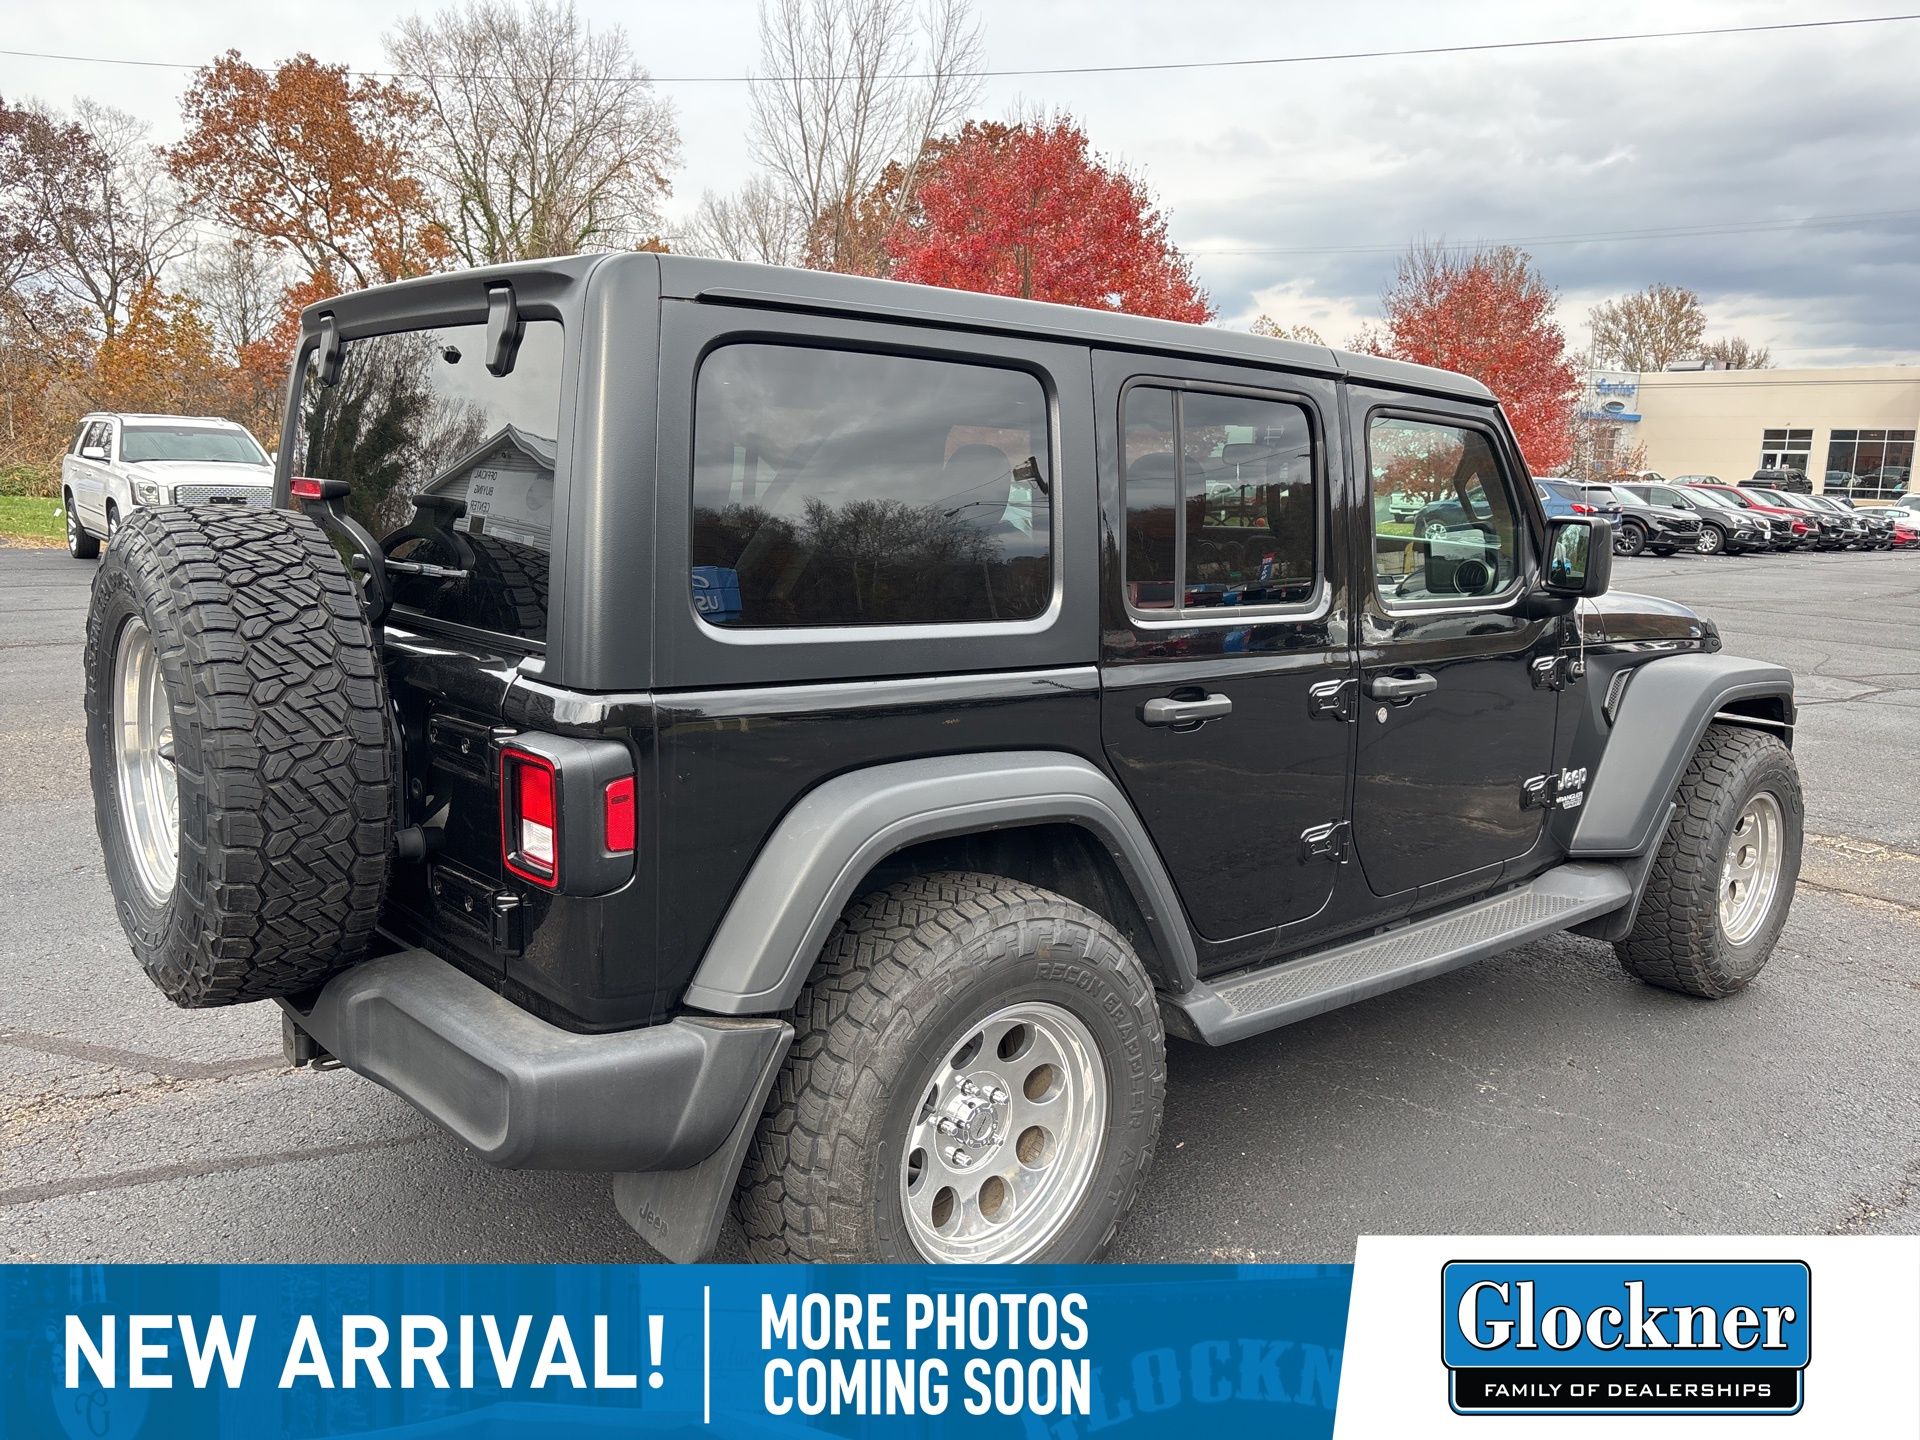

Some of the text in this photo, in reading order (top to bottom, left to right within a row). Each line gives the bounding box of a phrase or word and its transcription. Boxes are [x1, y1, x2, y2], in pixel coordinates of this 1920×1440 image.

[1557, 767, 1587, 791] Jeep
[1033, 962, 1105, 999] RECON
[639, 1202, 669, 1239] Jeep
